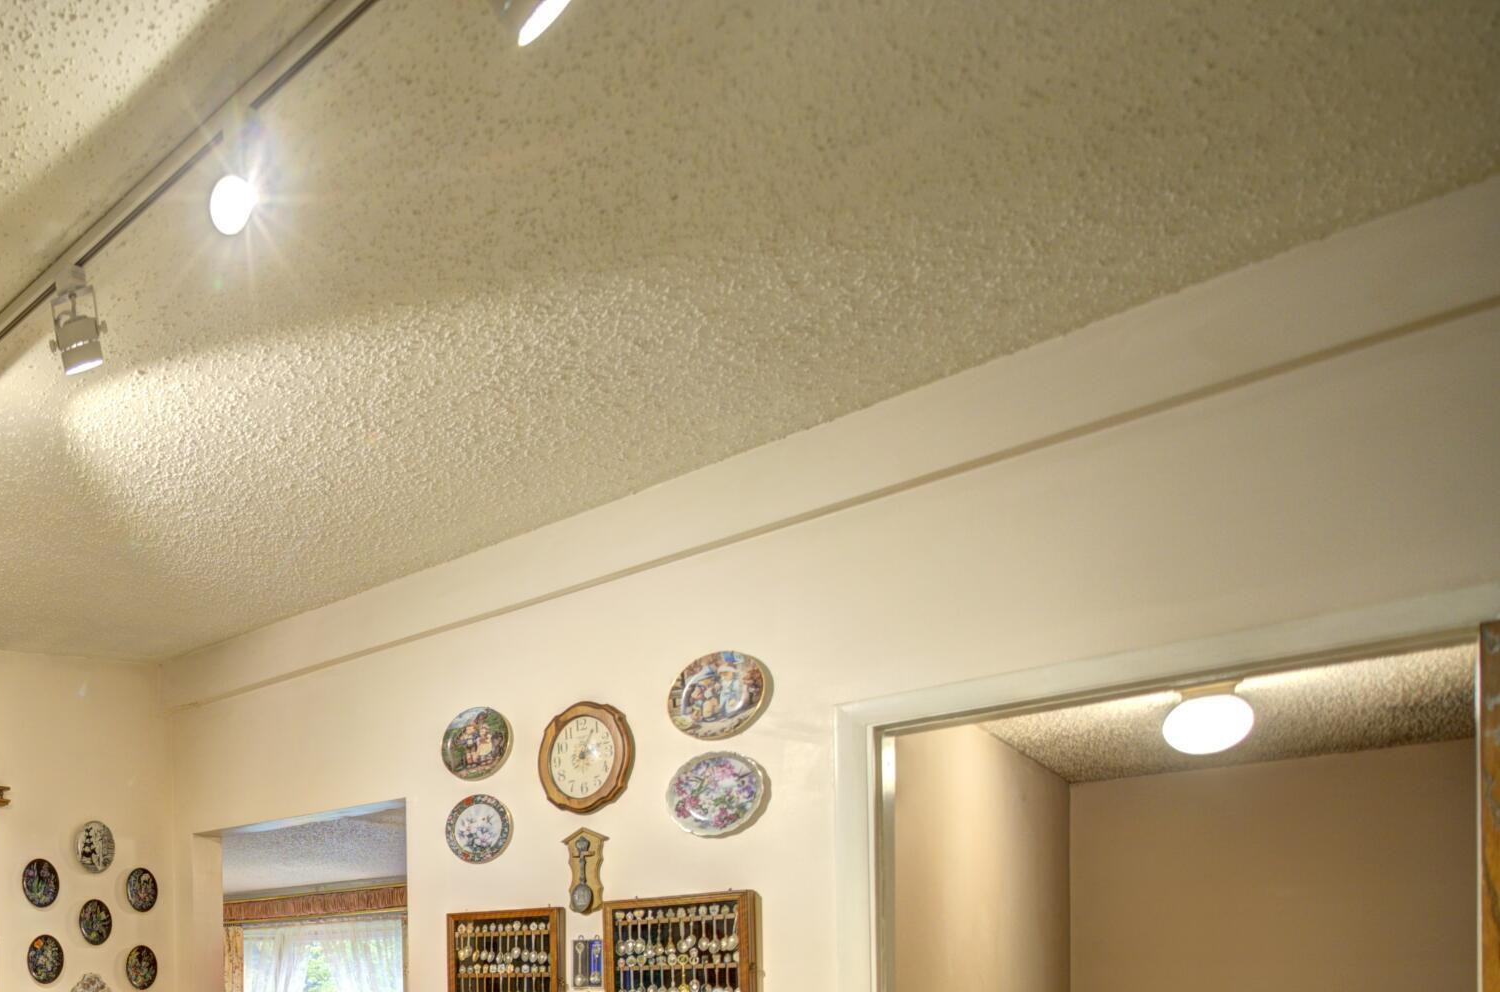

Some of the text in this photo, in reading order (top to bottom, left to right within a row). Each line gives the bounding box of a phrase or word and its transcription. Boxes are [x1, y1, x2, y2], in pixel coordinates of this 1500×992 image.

[576, 718, 588, 732] 12
[595, 720, 599, 733] 1
[565, 727, 573, 740] 11
[557, 741, 568, 754] 10
[553, 756, 561, 769] 9
[603, 759, 609, 773] 4
[557, 769, 566, 782] 8
[594, 774, 602, 787] 5
[568, 780, 575, 793] 7
[580, 782, 589, 795] 6
